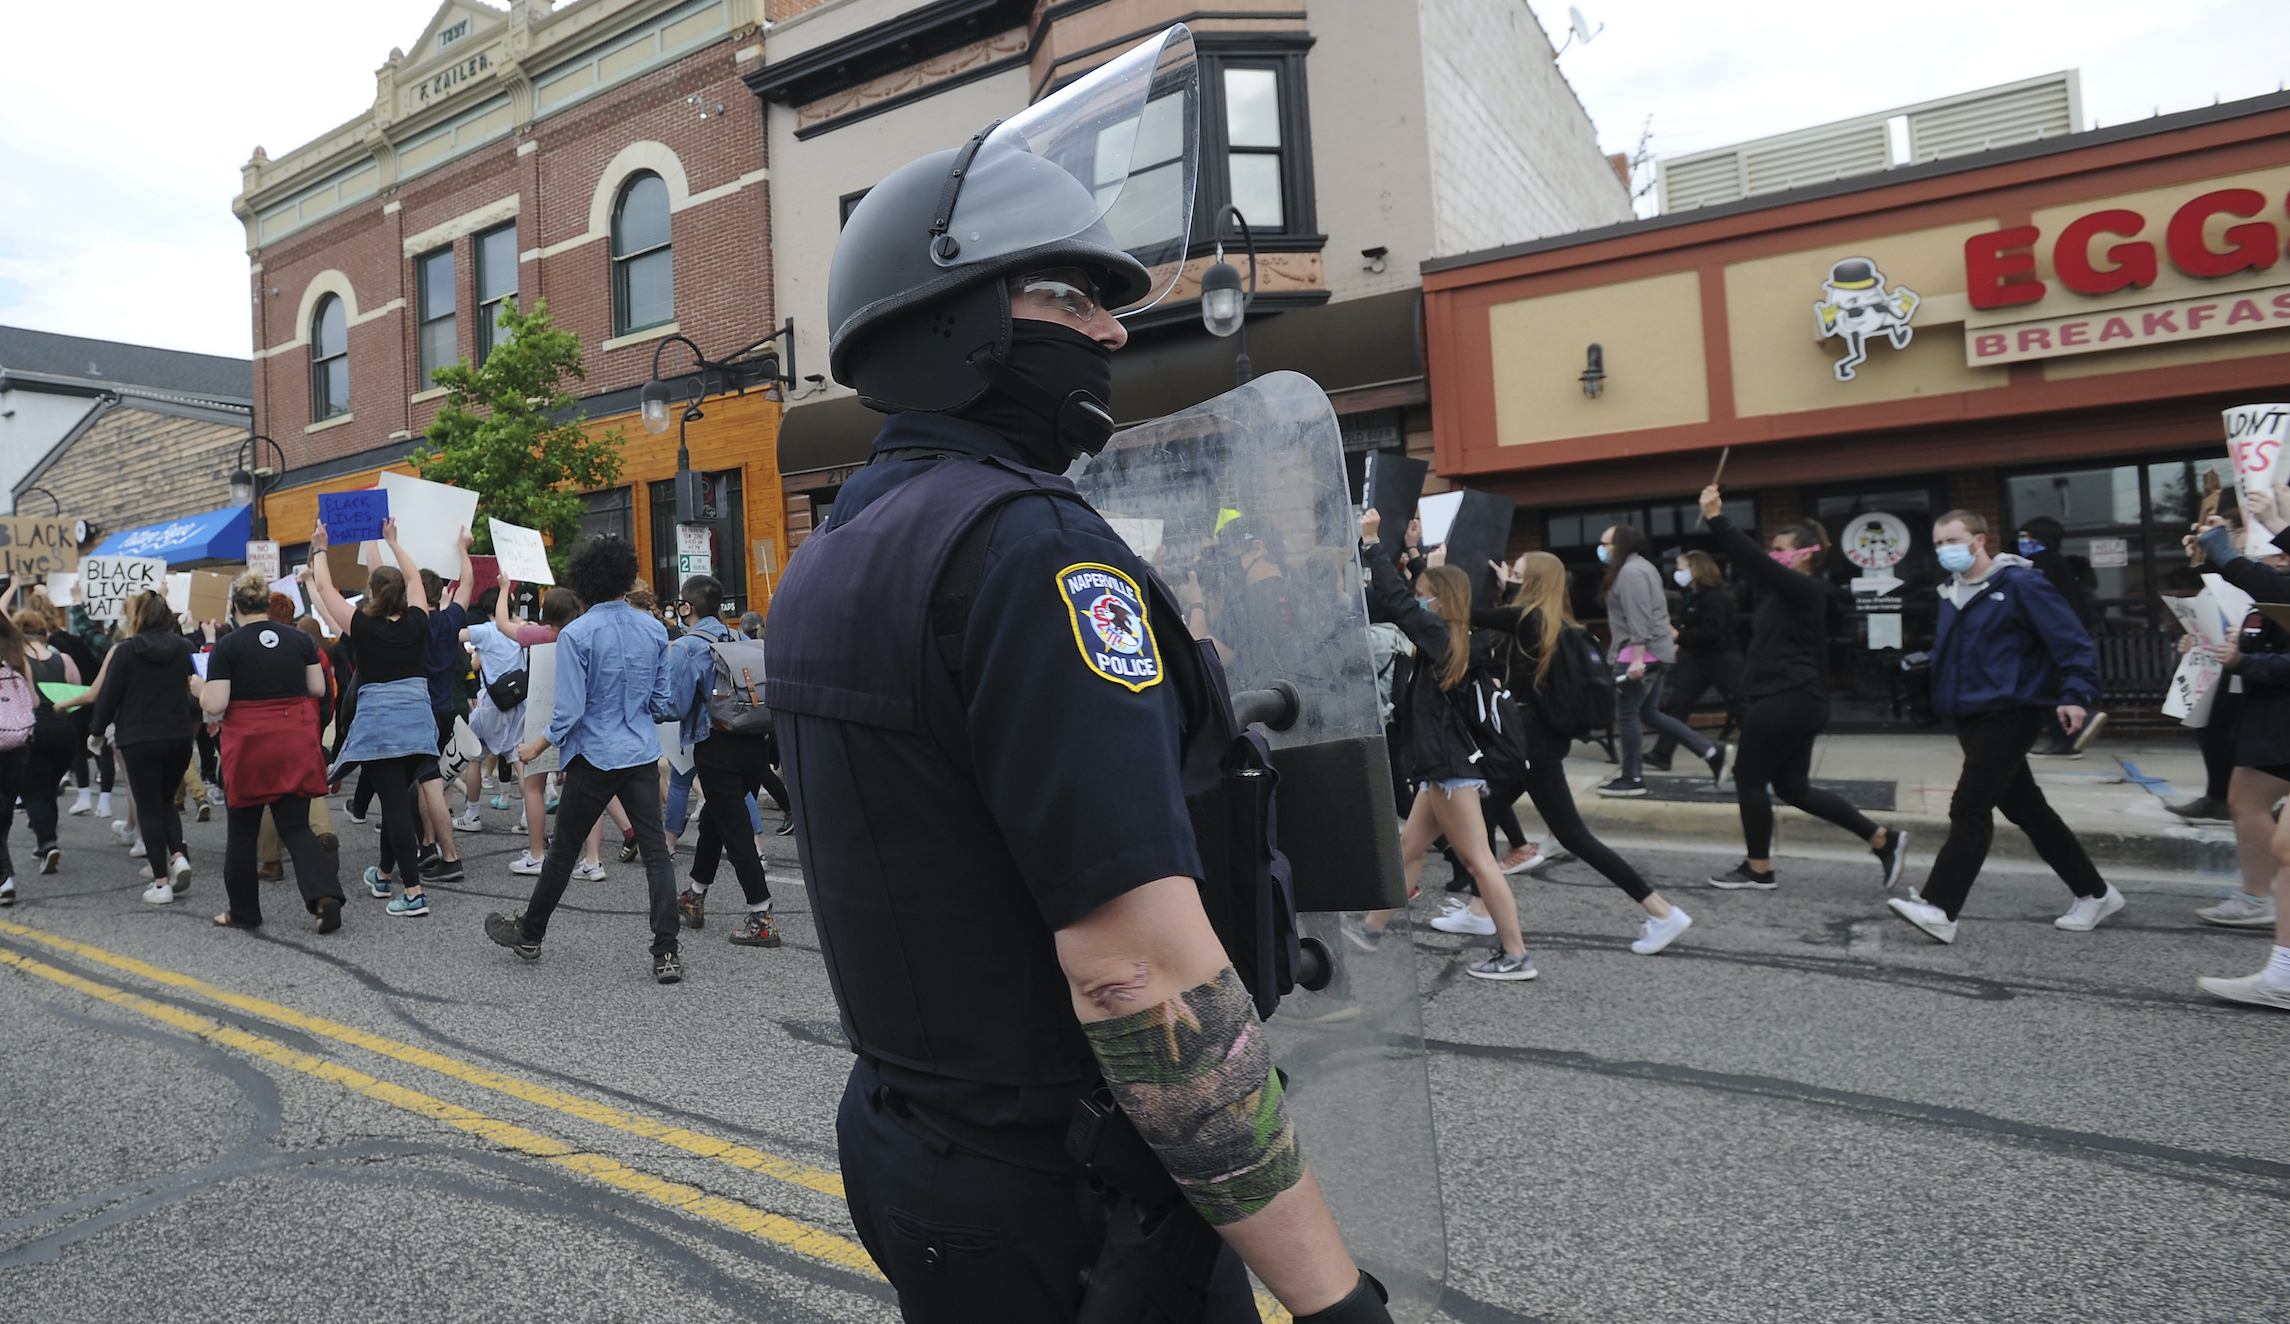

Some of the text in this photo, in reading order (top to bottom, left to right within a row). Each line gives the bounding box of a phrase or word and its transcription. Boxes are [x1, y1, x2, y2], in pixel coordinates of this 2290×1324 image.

[1964, 187, 2290, 311] EGG
[325, 496, 371, 513] BLACK
[327, 510, 372, 525] LIVES
[0, 524, 73, 548] BLACK
[88, 560, 154, 582] BLACK
[681, 557, 689, 571] 2
[1067, 573, 1138, 603] NAPERVILLE
[720, 602, 736, 612] TAPS
[1096, 652, 1157, 677] POLICE
